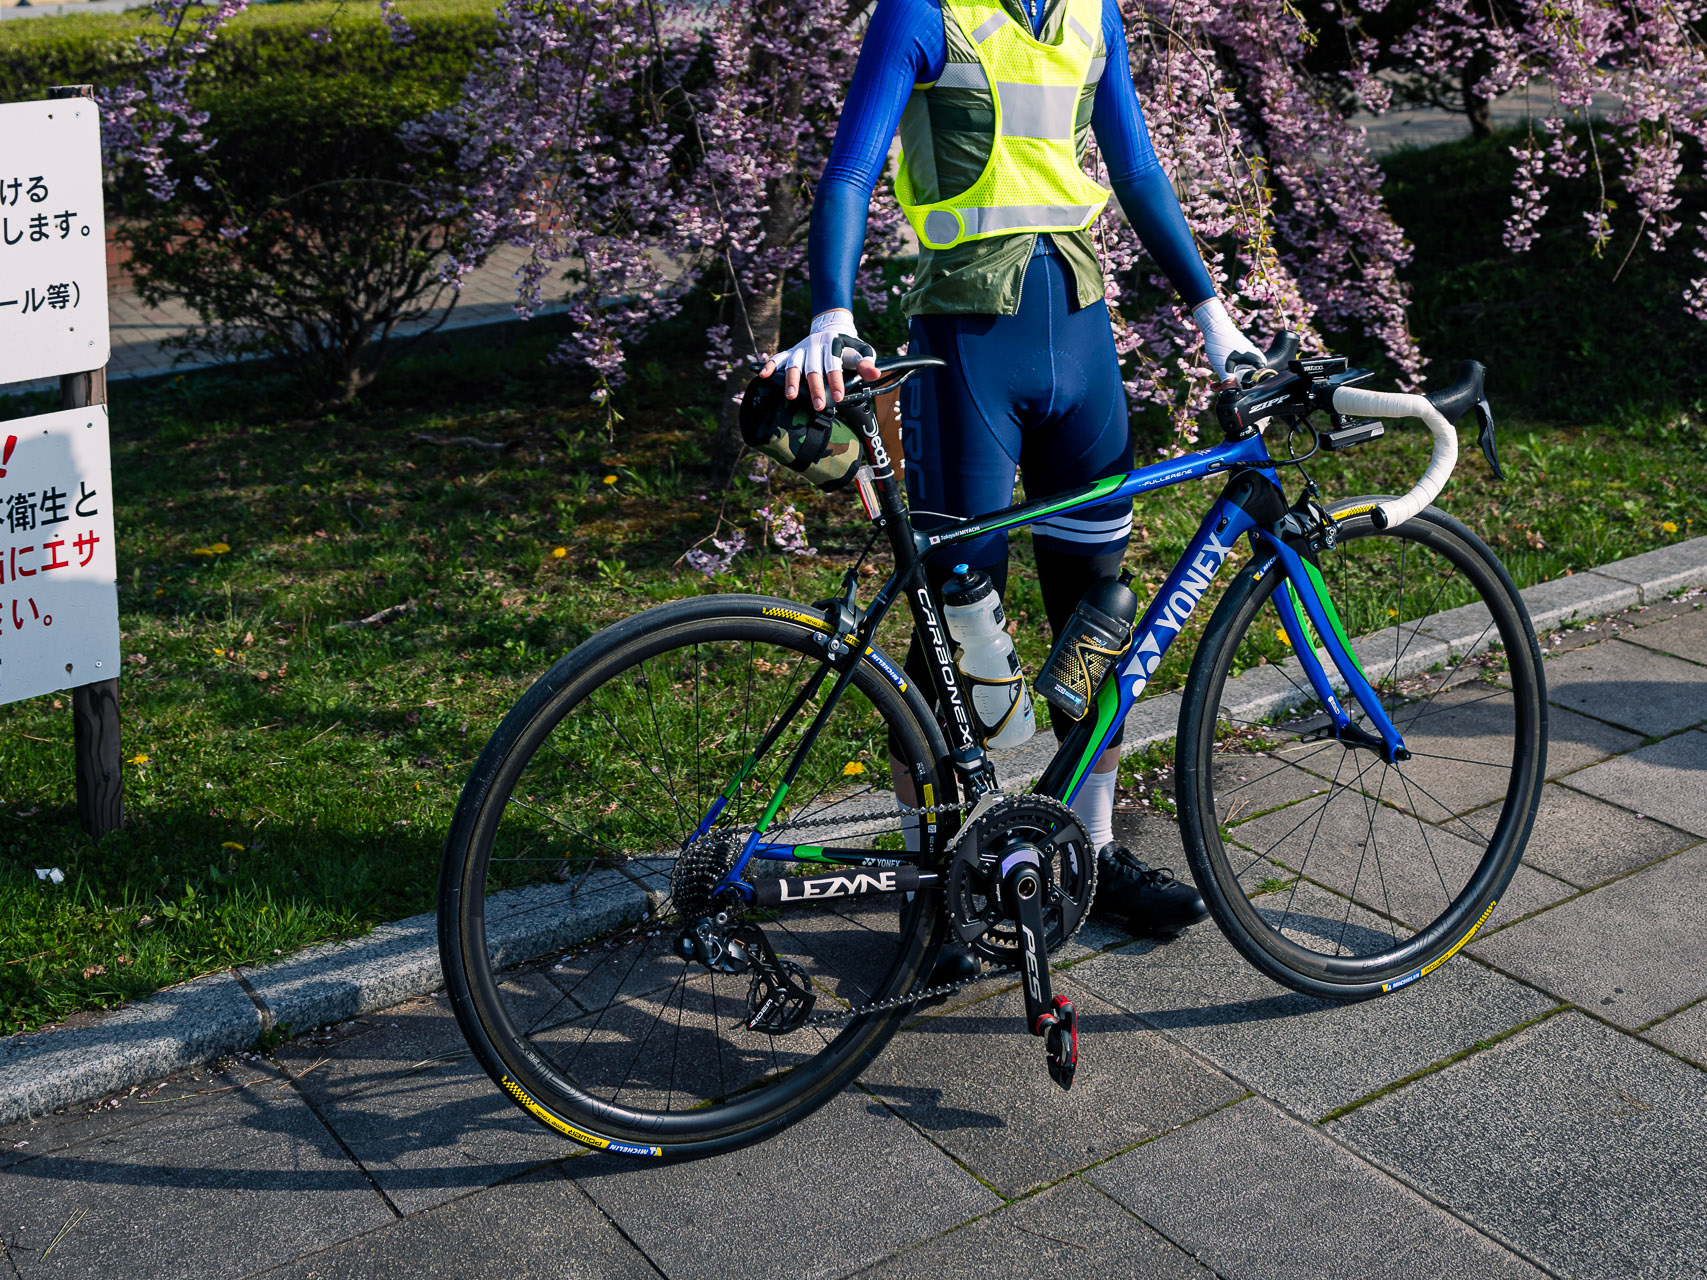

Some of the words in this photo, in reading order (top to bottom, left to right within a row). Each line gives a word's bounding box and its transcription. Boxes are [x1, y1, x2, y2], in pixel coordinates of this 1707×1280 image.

[0, 175, 49, 207] ける
[3, 209, 91, 246] します。
[1248, 393, 1291, 414] ZIPP
[0, 480, 99, 534] 衛生と
[0, 529, 101, 585] にエサ
[1154, 531, 1233, 633] YONEX
[0, 597, 53, 636] い。
[870, 652, 901, 683] MICHELIN
[916, 587, 974, 746] CARBONEX
[876, 858, 901, 868] YONEX
[778, 871, 897, 902] LEZYNE
[1021, 923, 1043, 1004] PES
[1392, 972, 1421, 989] MICHELIN
[749, 998, 774, 1029] RIDEA
[567, 1129, 603, 1148] POWER
[609, 1143, 649, 1156] MICHELIN
